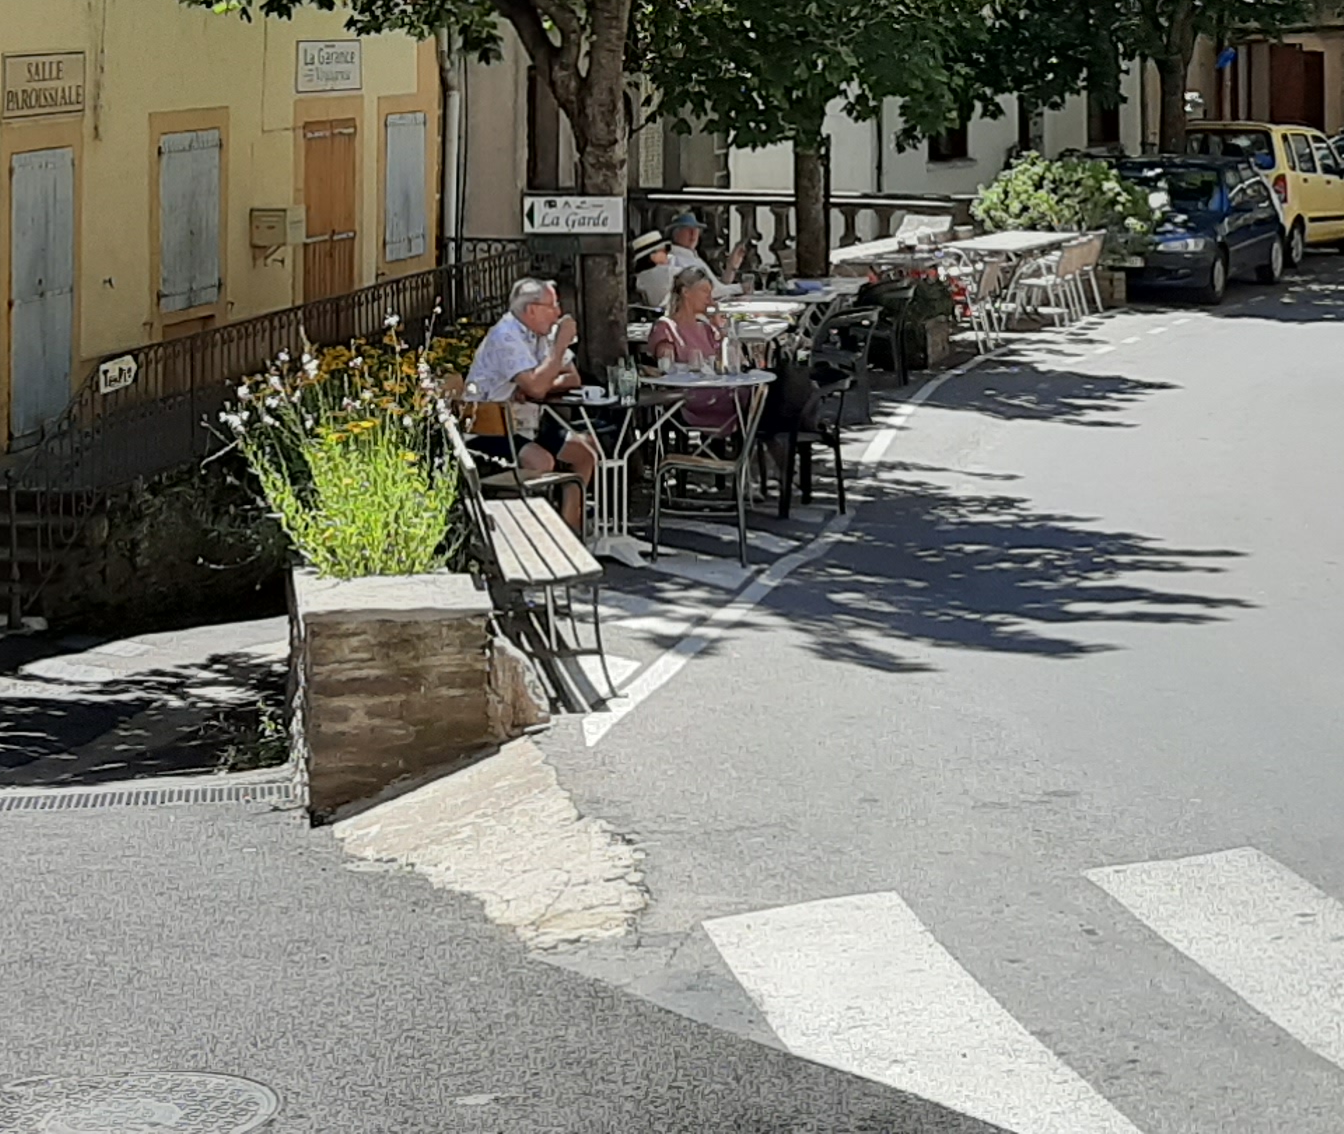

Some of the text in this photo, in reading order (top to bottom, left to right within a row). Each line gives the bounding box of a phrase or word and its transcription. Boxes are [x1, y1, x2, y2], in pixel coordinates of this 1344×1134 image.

[304, 48, 315, 66] La
[26, 60, 64, 83] SALLE
[6, 85, 83, 111] PAROISSIALE
[540, 210, 609, 233] La Garde
